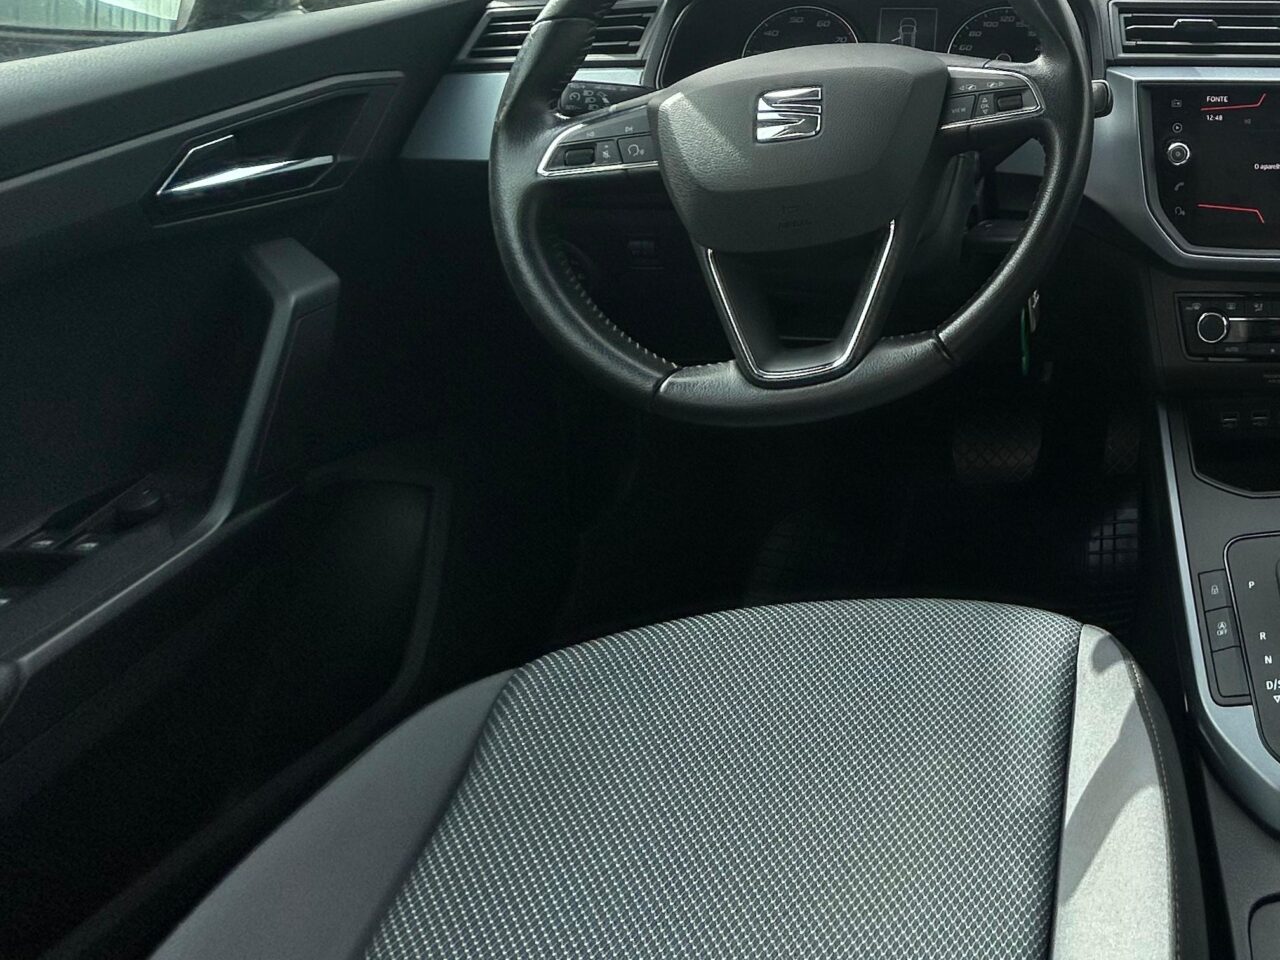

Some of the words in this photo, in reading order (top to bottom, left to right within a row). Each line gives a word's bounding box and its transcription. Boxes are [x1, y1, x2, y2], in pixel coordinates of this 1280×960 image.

[1206, 95, 1229, 103] FONTE
[1259, 631, 1267, 640] R
[1264, 655, 1273, 664] N
